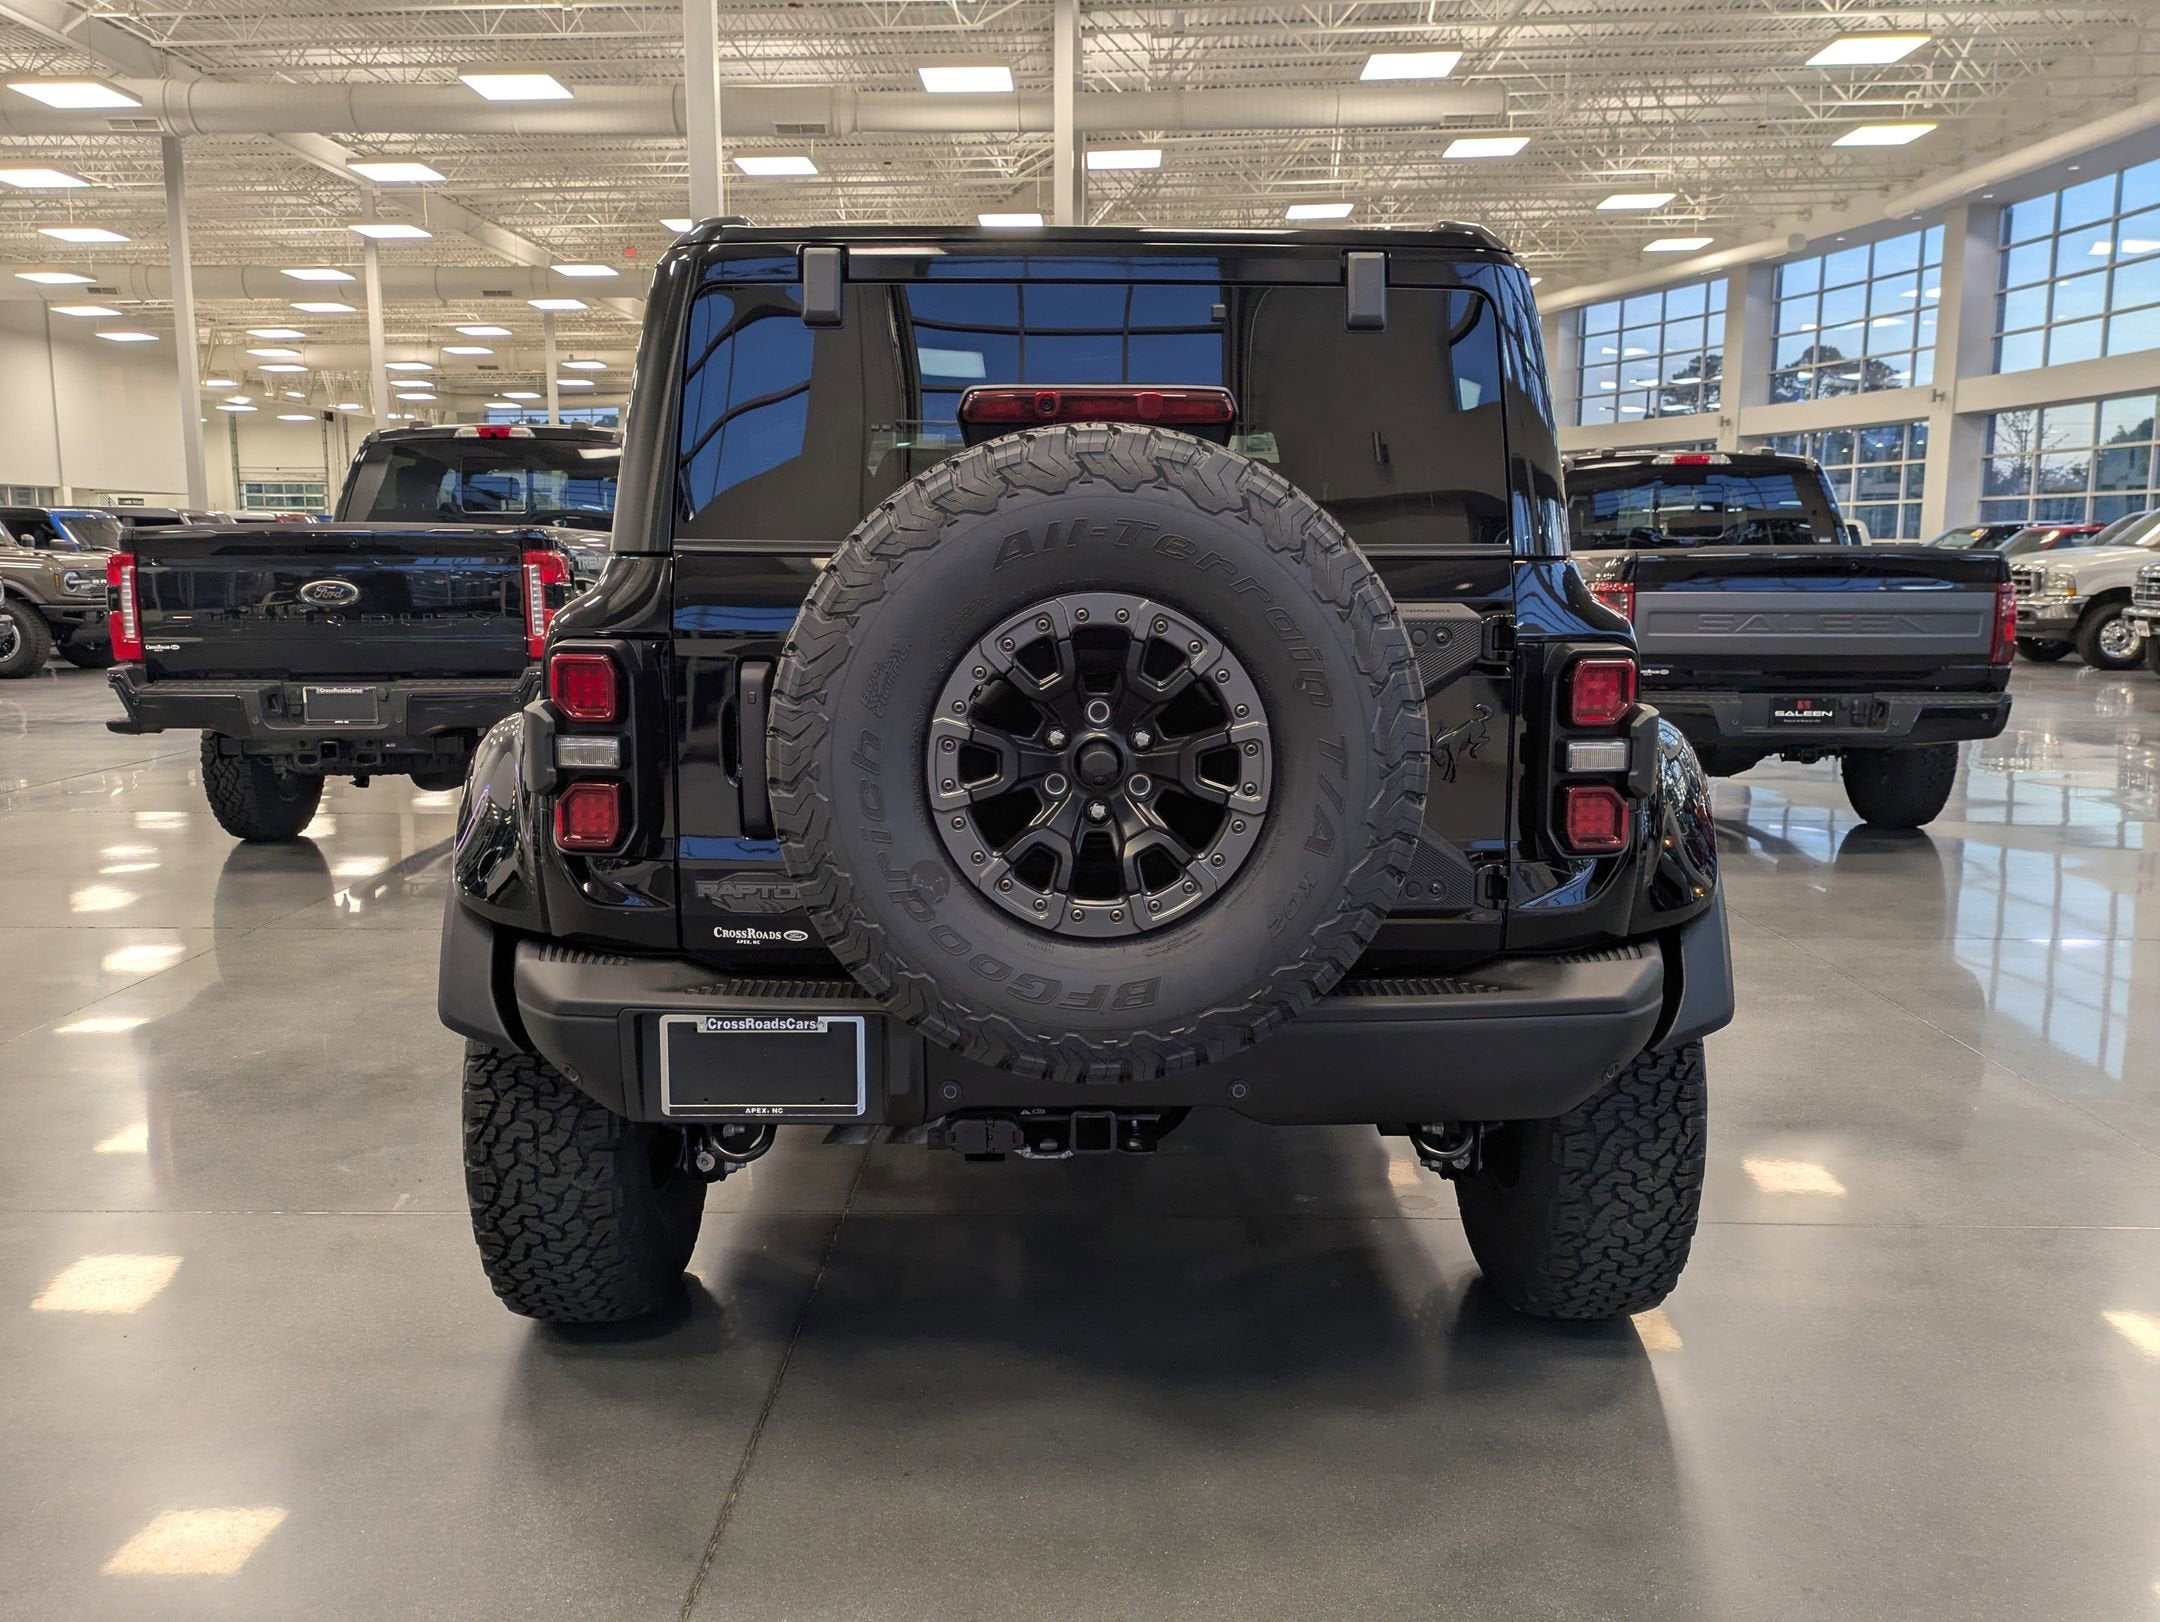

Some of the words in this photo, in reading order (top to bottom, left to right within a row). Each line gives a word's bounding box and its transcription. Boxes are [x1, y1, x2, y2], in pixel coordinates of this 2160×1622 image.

[1697, 614, 1932, 633] SALEEN
[992, 517, 1333, 707] All-Terrain
[1303, 734, 1350, 857] T/A
[852, 728, 1162, 1011] BFGoodrich
[696, 882, 801, 898] RAPTO
[707, 1017, 817, 1030] CrossRoadsCars
[771, 1107, 784, 1115] NC
